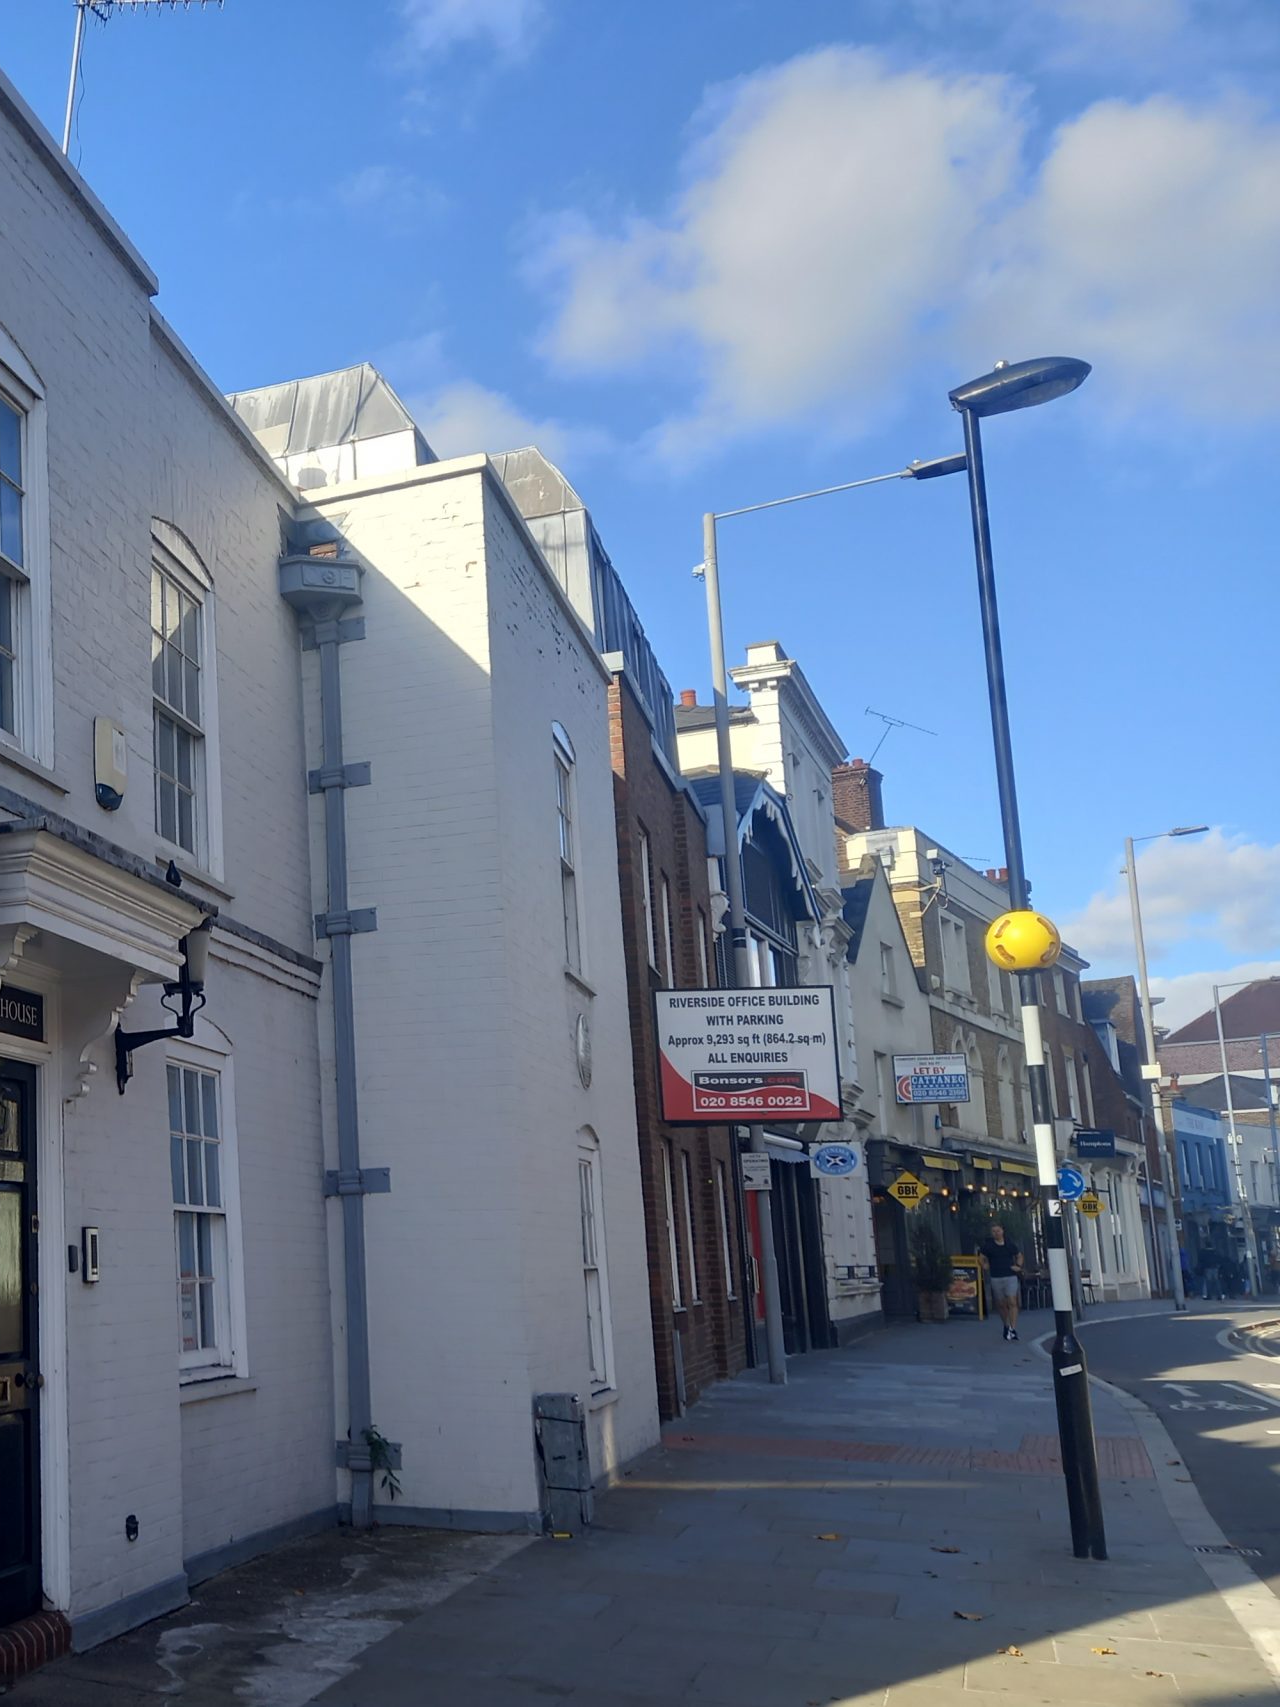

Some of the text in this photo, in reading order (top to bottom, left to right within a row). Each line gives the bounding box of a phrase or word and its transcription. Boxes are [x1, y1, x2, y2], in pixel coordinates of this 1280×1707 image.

[669, 994, 819, 1008] RIVERSIDE OFFICE BUILDING
[0, 998, 37, 1026] HOUSE
[706, 1014, 784, 1026] WITH PARKING
[668, 1032, 826, 1047] Approx 9,293 sq ft (864.2 sq m)
[707, 1052, 788, 1063] ALL ENQUIRIES
[913, 1066, 946, 1075] LET BY
[911, 1075, 964, 1085] CATTANEO
[700, 1096, 802, 1107] 020 8546 0022
[897, 1186, 918, 1196] GBK
[1082, 1203, 1098, 1211] GBK
